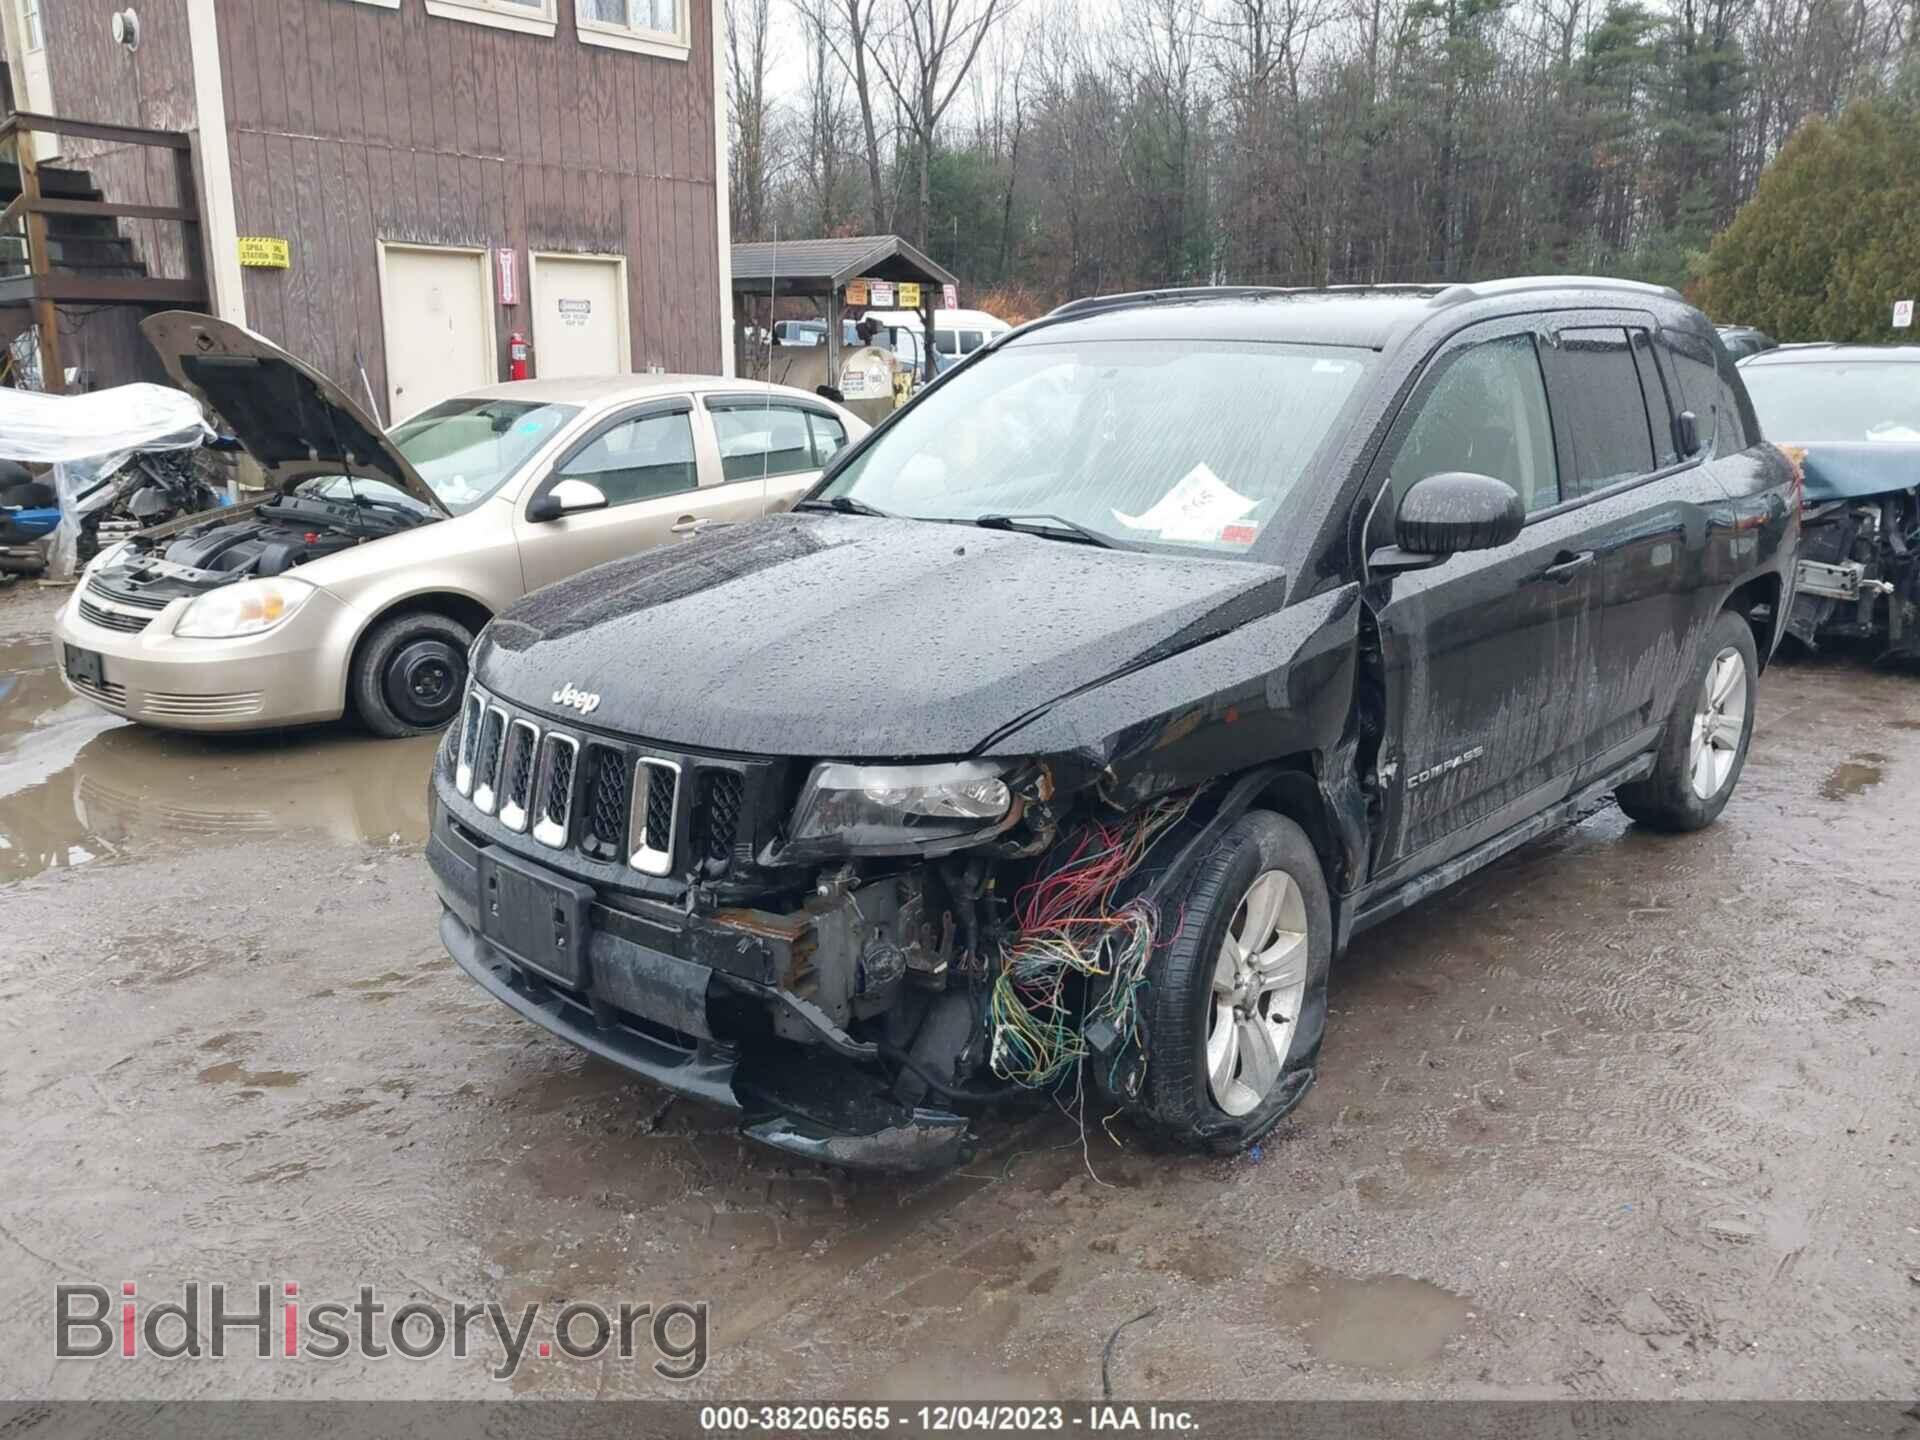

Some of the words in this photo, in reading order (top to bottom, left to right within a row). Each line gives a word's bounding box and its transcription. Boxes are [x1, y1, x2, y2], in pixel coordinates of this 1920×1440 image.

[241, 251, 269, 260] STATION
[245, 243, 264, 251] SPILL
[551, 682, 601, 715] Jeep
[1407, 745, 1484, 790] COMPASS
